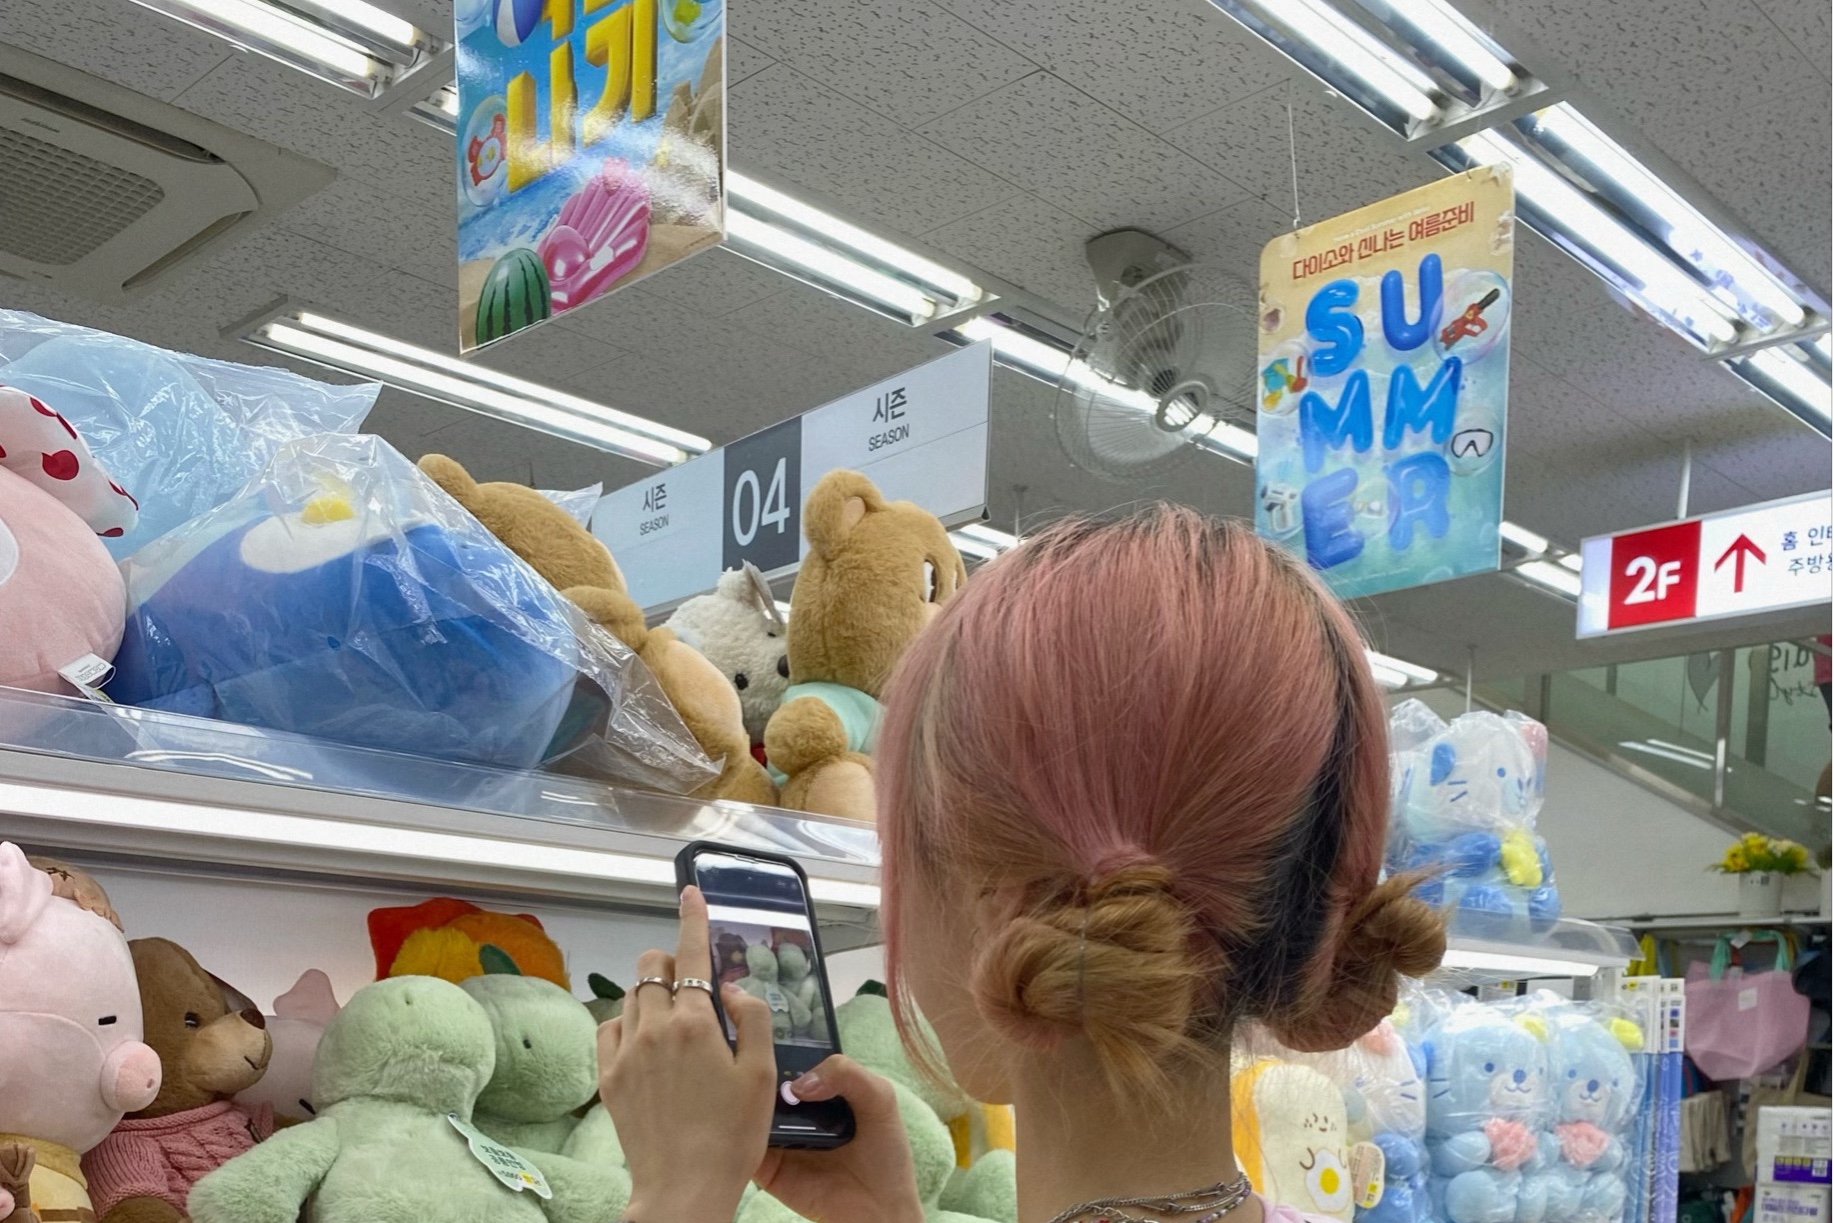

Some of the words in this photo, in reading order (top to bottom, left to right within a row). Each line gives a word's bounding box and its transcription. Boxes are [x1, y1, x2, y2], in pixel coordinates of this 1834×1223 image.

[1293, 243, 1354, 280] 다이소와
[1357, 228, 1405, 260] 신나는
[1408, 201, 1475, 241] 여름준비
[872, 387, 907, 424] 시즌
[868, 424, 910, 452] SEASON
[642, 483, 668, 513] 시즌
[733, 457, 790, 547] 04
[639, 514, 669, 536] SEASON
[1781, 530, 1799, 551] 홈
[1623, 556, 1681, 606] 2F
